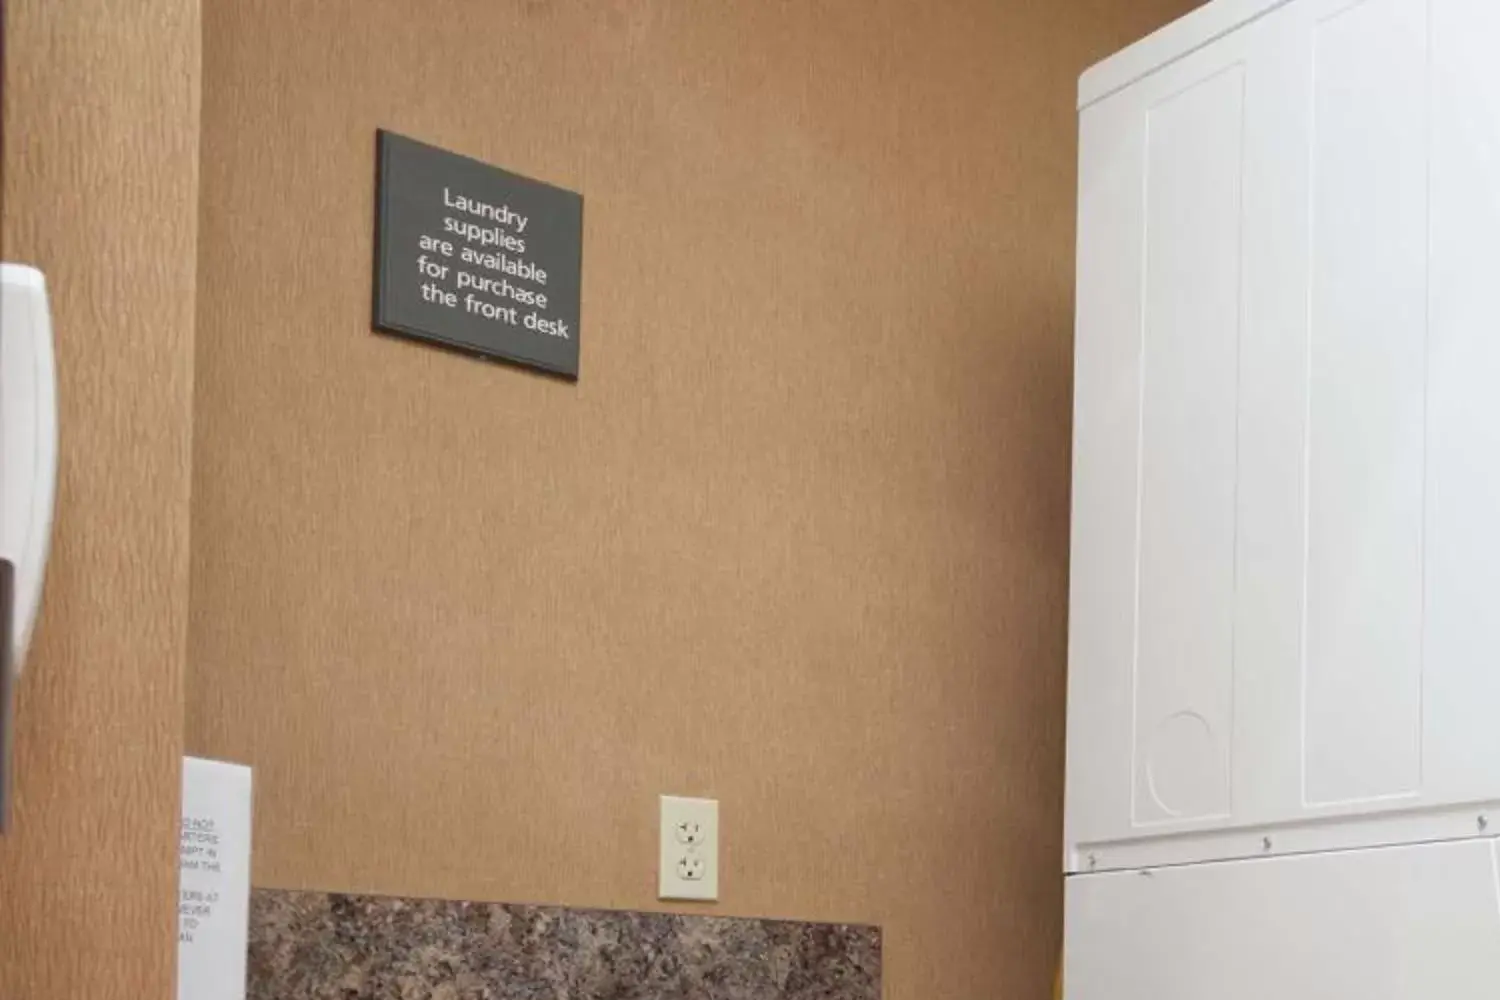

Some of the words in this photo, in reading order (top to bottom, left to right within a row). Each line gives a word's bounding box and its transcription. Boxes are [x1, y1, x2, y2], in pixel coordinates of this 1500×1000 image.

[444, 187, 528, 232] Laundry
[444, 216, 525, 253] supplies
[417, 255, 448, 280] for
[457, 271, 548, 309] purchase
[419, 234, 453, 256] are
[460, 246, 547, 285] available
[421, 284, 458, 308] the
[464, 294, 518, 325] front
[523, 312, 570, 340] desk
